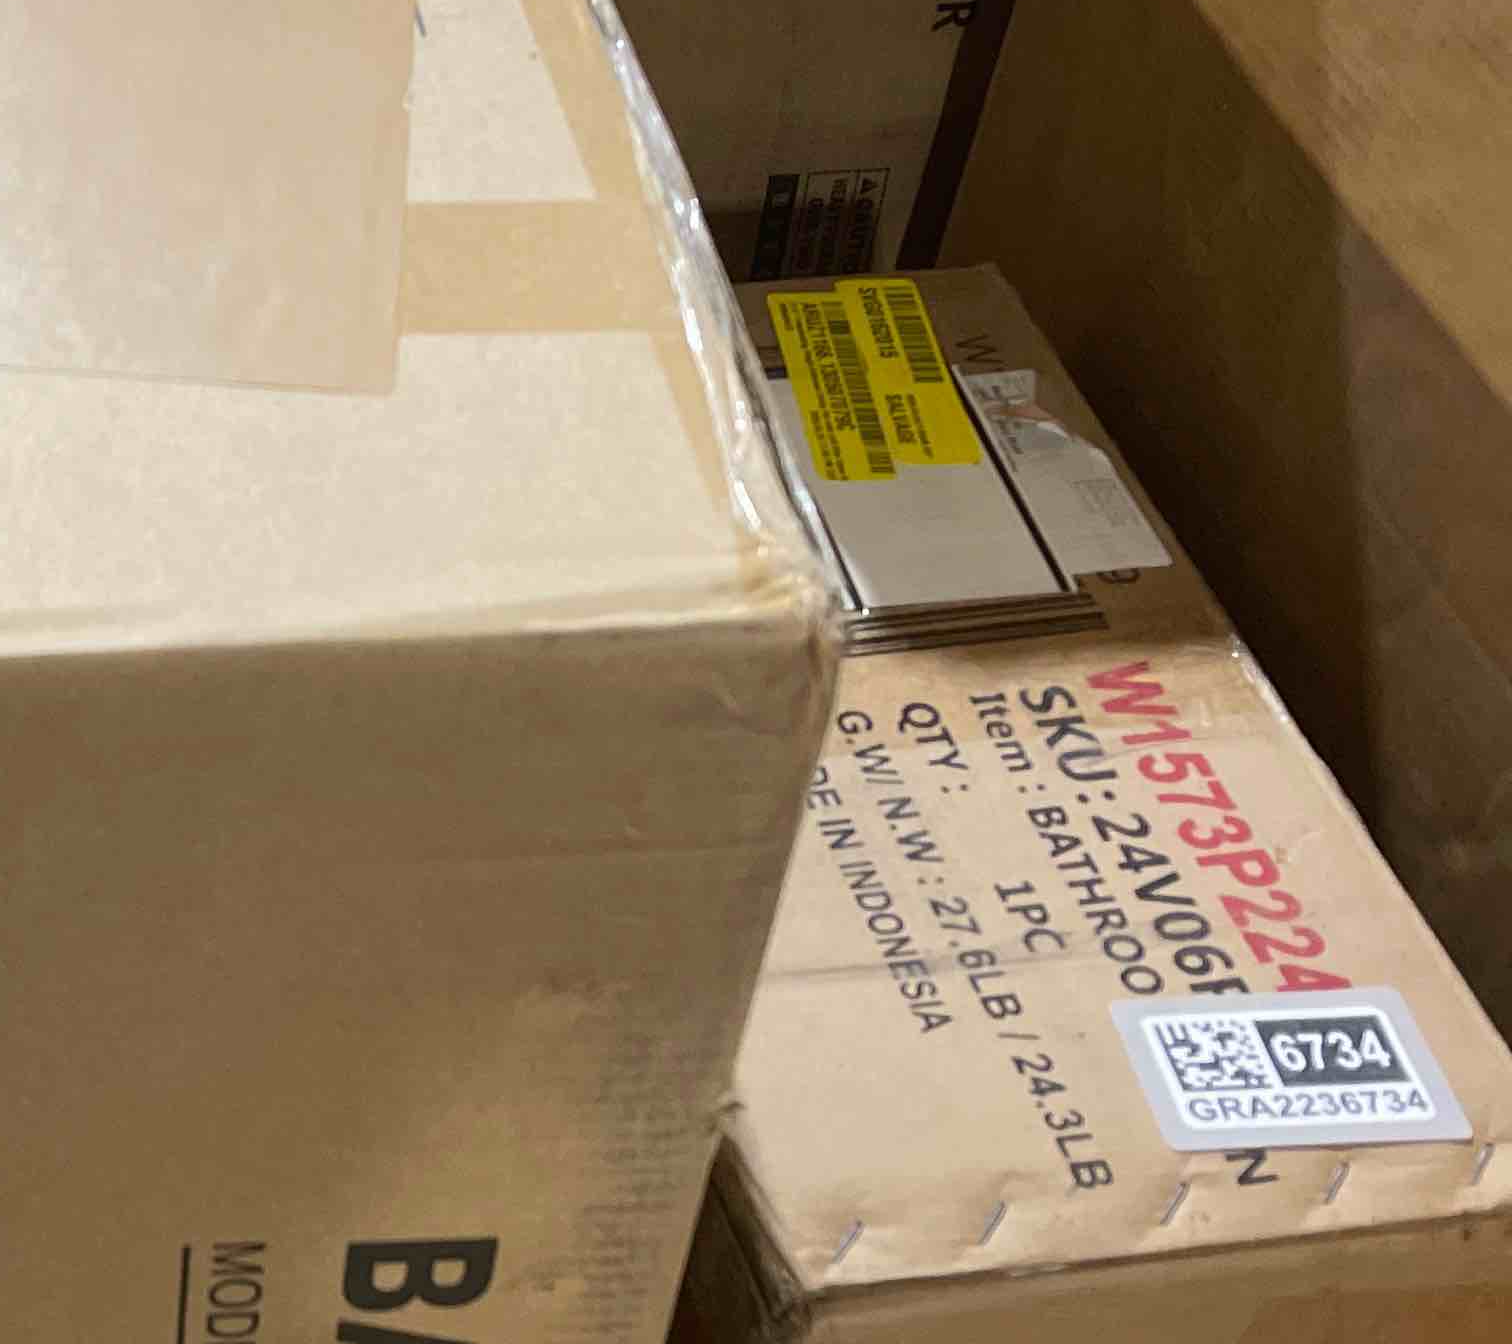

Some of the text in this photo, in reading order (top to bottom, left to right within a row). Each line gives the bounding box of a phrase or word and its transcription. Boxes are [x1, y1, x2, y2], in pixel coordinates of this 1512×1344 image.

[1019, 686, 1118, 804] SKU:
[816, 817, 865, 851] IN
[1086, 661, 1352, 992] W1573P224
[839, 860, 953, 1033] INDONESIA
[994, 880, 1067, 953] 1PC
[1027, 806, 1164, 996] BATHROO
[930, 896, 1023, 1020] 27.6LB
[1011, 1052, 1114, 1189] 24.3LB
[1269, 1029, 1392, 1073] 6734
[1188, 1089, 1430, 1122] GRA2236734
